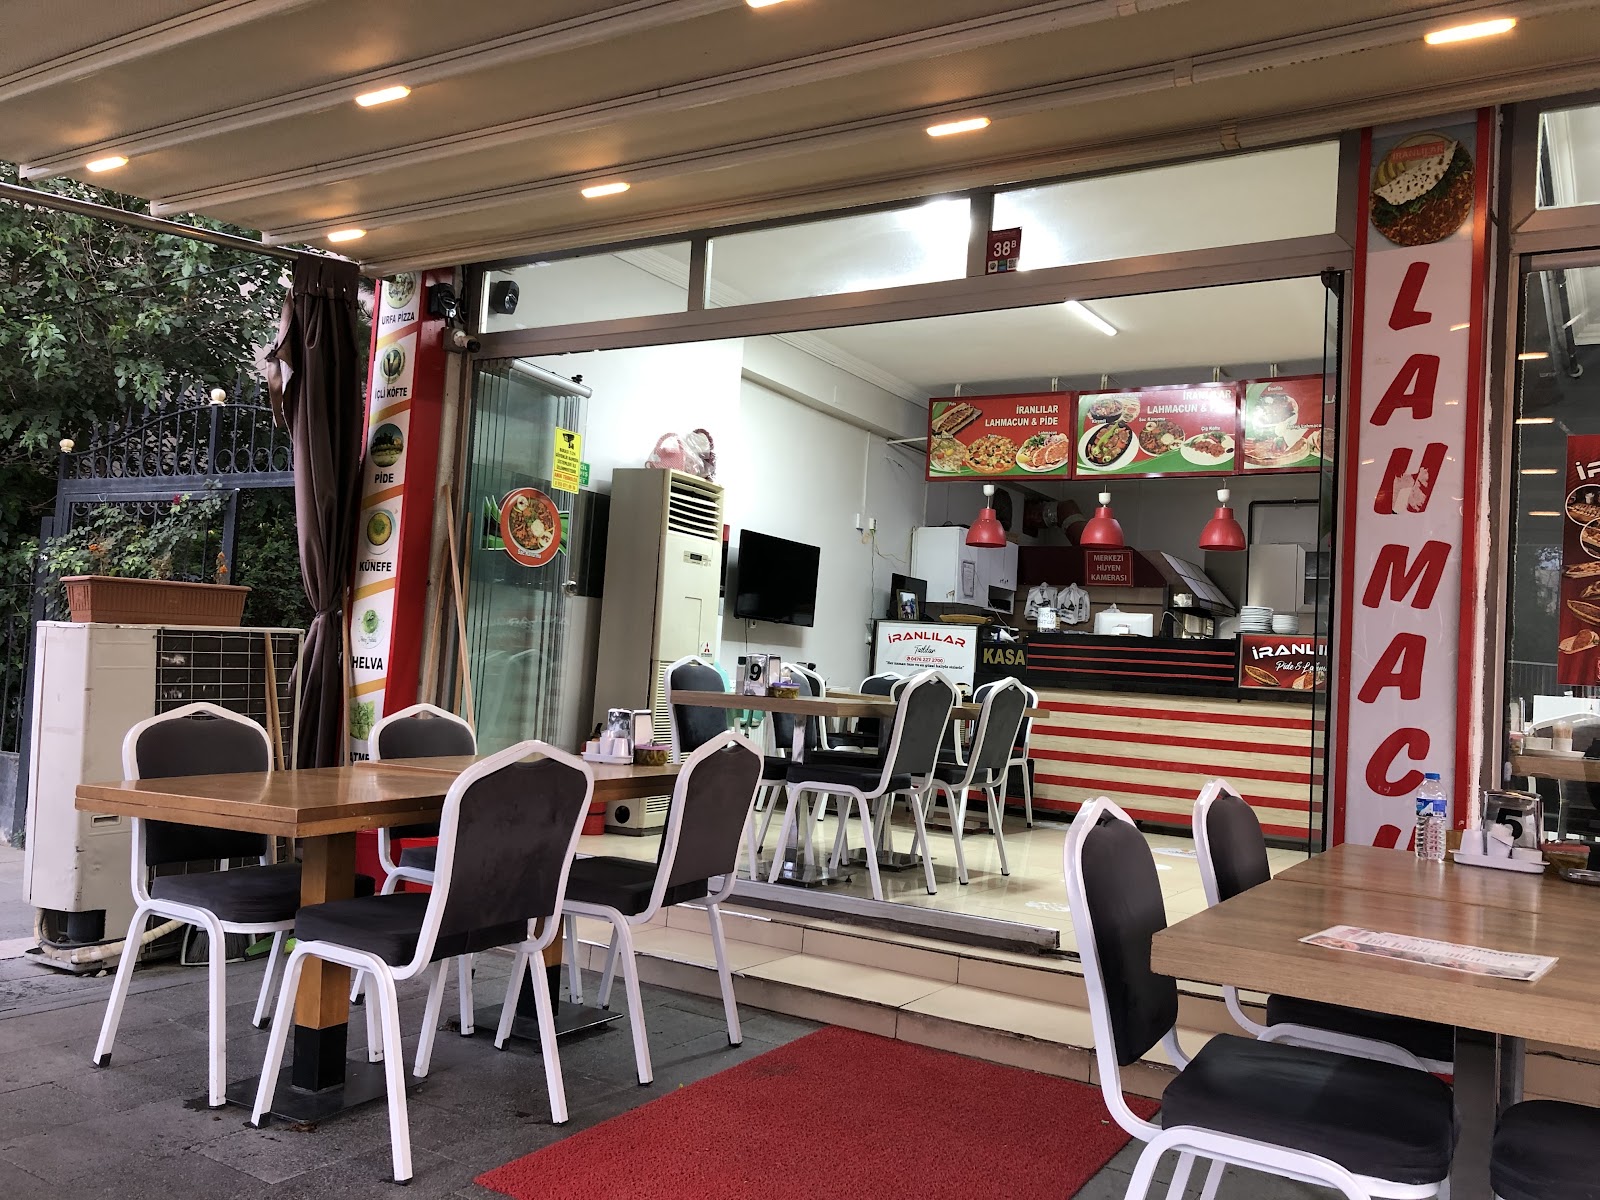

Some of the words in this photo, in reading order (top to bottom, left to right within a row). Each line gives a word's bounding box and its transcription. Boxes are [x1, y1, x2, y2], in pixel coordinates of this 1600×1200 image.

[381, 313, 397, 325] URFA
[397, 311, 415, 323] PİZZA
[374, 388, 386, 401] İÇLİ
[386, 386, 408, 398] KÖFTE
[1016, 405, 1059, 414] İRANLILAR
[1147, 403, 1198, 414] LAHMACUN
[1201, 403, 1207, 413] &
[985, 417, 1029, 427] LAHMACUN
[1031, 417, 1037, 426] &
[1039, 415, 1058, 426] PİDE
[374, 472, 394, 484] PİDE
[1093, 554, 1124, 562] MERKEZİ
[1358, 262, 1452, 850] LAHMAC
[358, 559, 392, 573] KÜNEFE
[1091, 573, 1127, 582] KAMERASI
[983, 648, 1026, 666] KASA
[1252, 643, 1327, 660] İRANLI
[351, 656, 384, 671] HELVA
[1276, 660, 1294, 671] Pide
[749, 663, 762, 682] 9
[1496, 807, 1523, 841] 5
